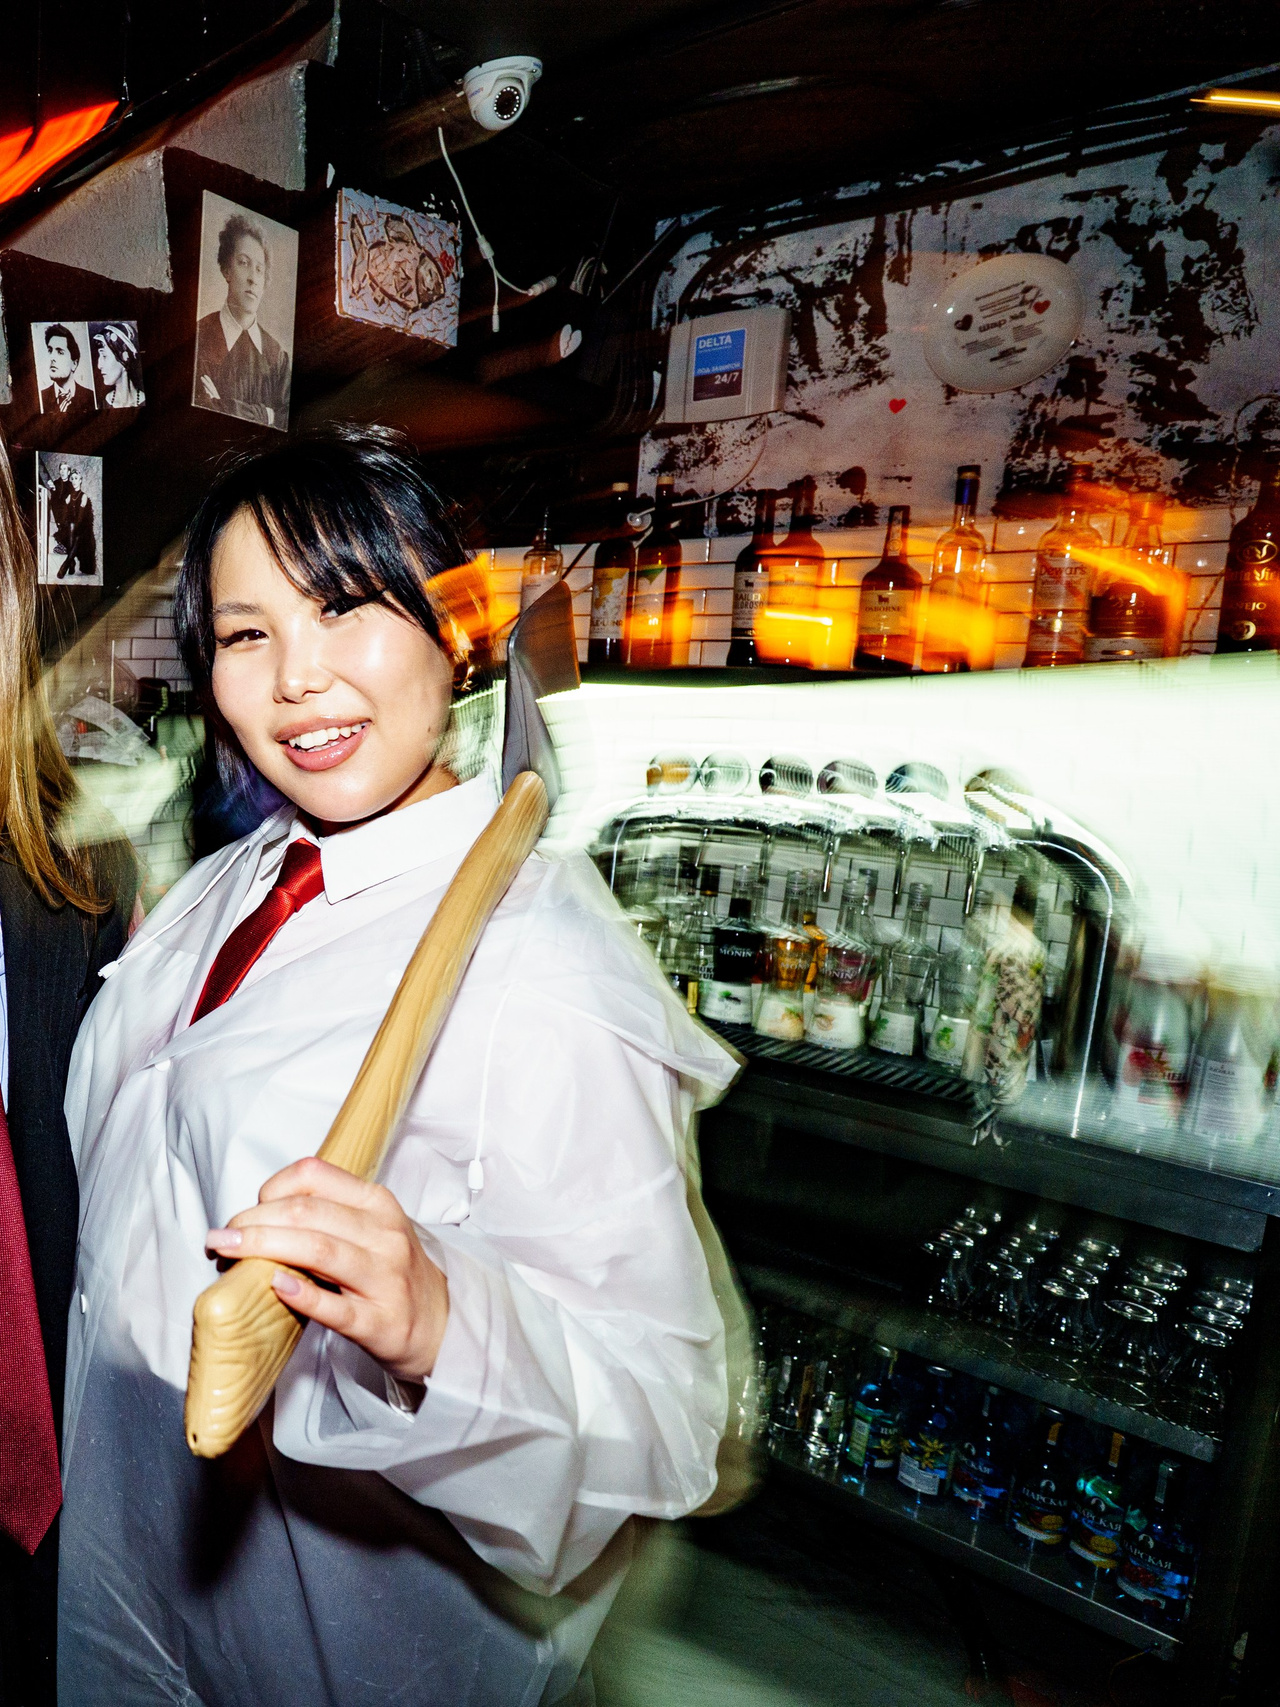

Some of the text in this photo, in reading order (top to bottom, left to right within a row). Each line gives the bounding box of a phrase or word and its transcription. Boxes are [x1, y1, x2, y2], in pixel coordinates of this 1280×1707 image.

[698, 334, 733, 349] DELTA
[714, 372, 739, 385] 24/7
[719, 948, 753, 958] MONIN
[780, 958, 811, 970] MON
[824, 969, 853, 980] ONIN
